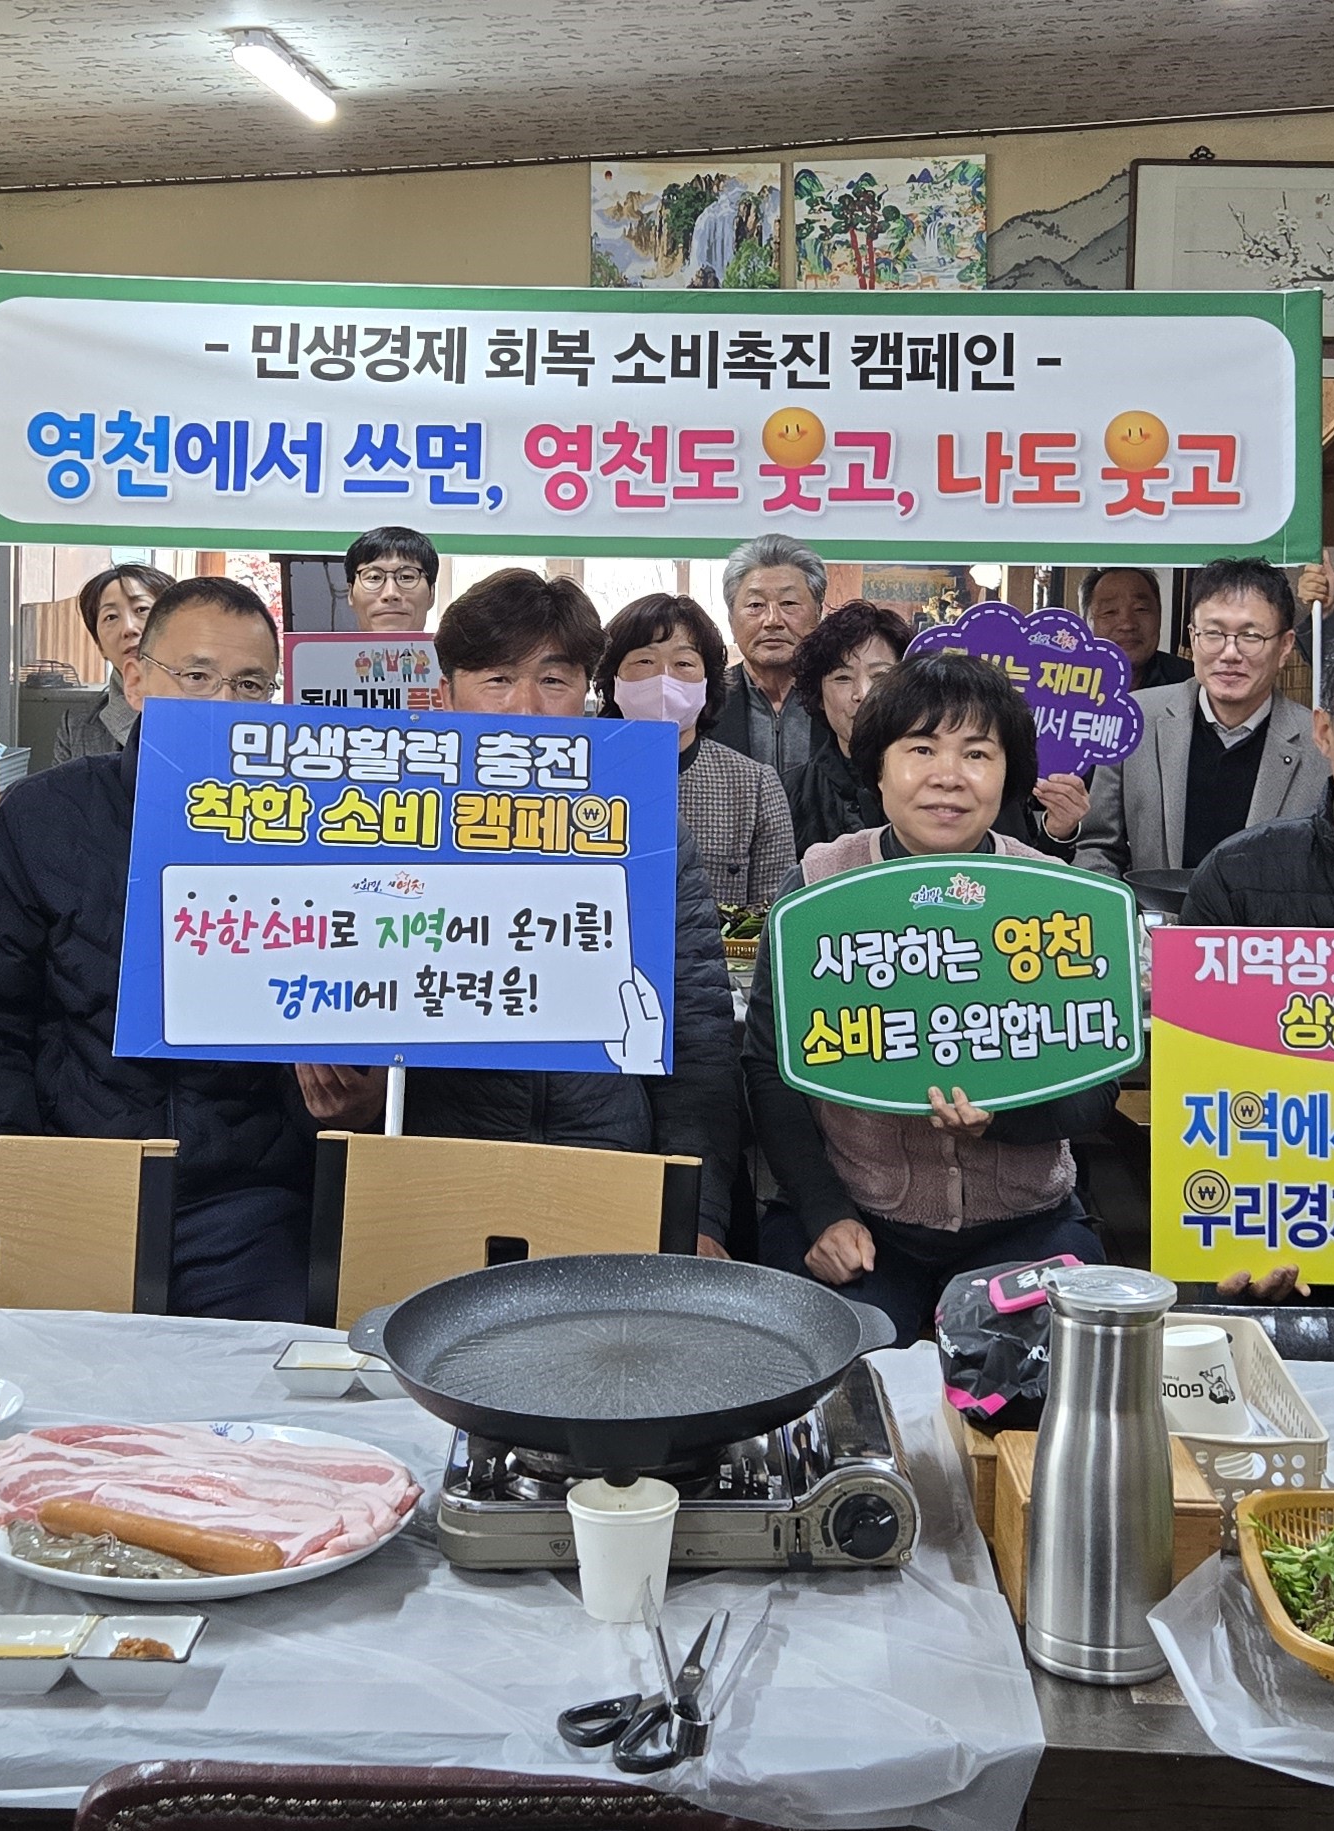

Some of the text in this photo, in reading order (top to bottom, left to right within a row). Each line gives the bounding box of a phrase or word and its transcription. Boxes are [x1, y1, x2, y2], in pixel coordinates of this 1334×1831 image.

[250, 323, 467, 385] 민생경제
[485, 327, 596, 387] 회복
[612, 328, 832, 390] 소비촉진
[851, 331, 1016, 392] 캠페인
[27, 406, 1243, 517] 영천에서 쓰면, 영천도 웃고, 나도 웃고
[1036, 660, 1107, 707] 재미,
[229, 720, 591, 791] 민생활력 충전
[1070, 711, 1124, 750] 두배!
[186, 779, 630, 856] 착한 소비 캠페인
[173, 901, 614, 956] 착한소비로 지역에 온기를!
[813, 910, 1108, 987] 사랑하는 영천,
[269, 965, 538, 1021] 경제에 활력을!
[801, 999, 1131, 1067] 소비로 응원합니다.
